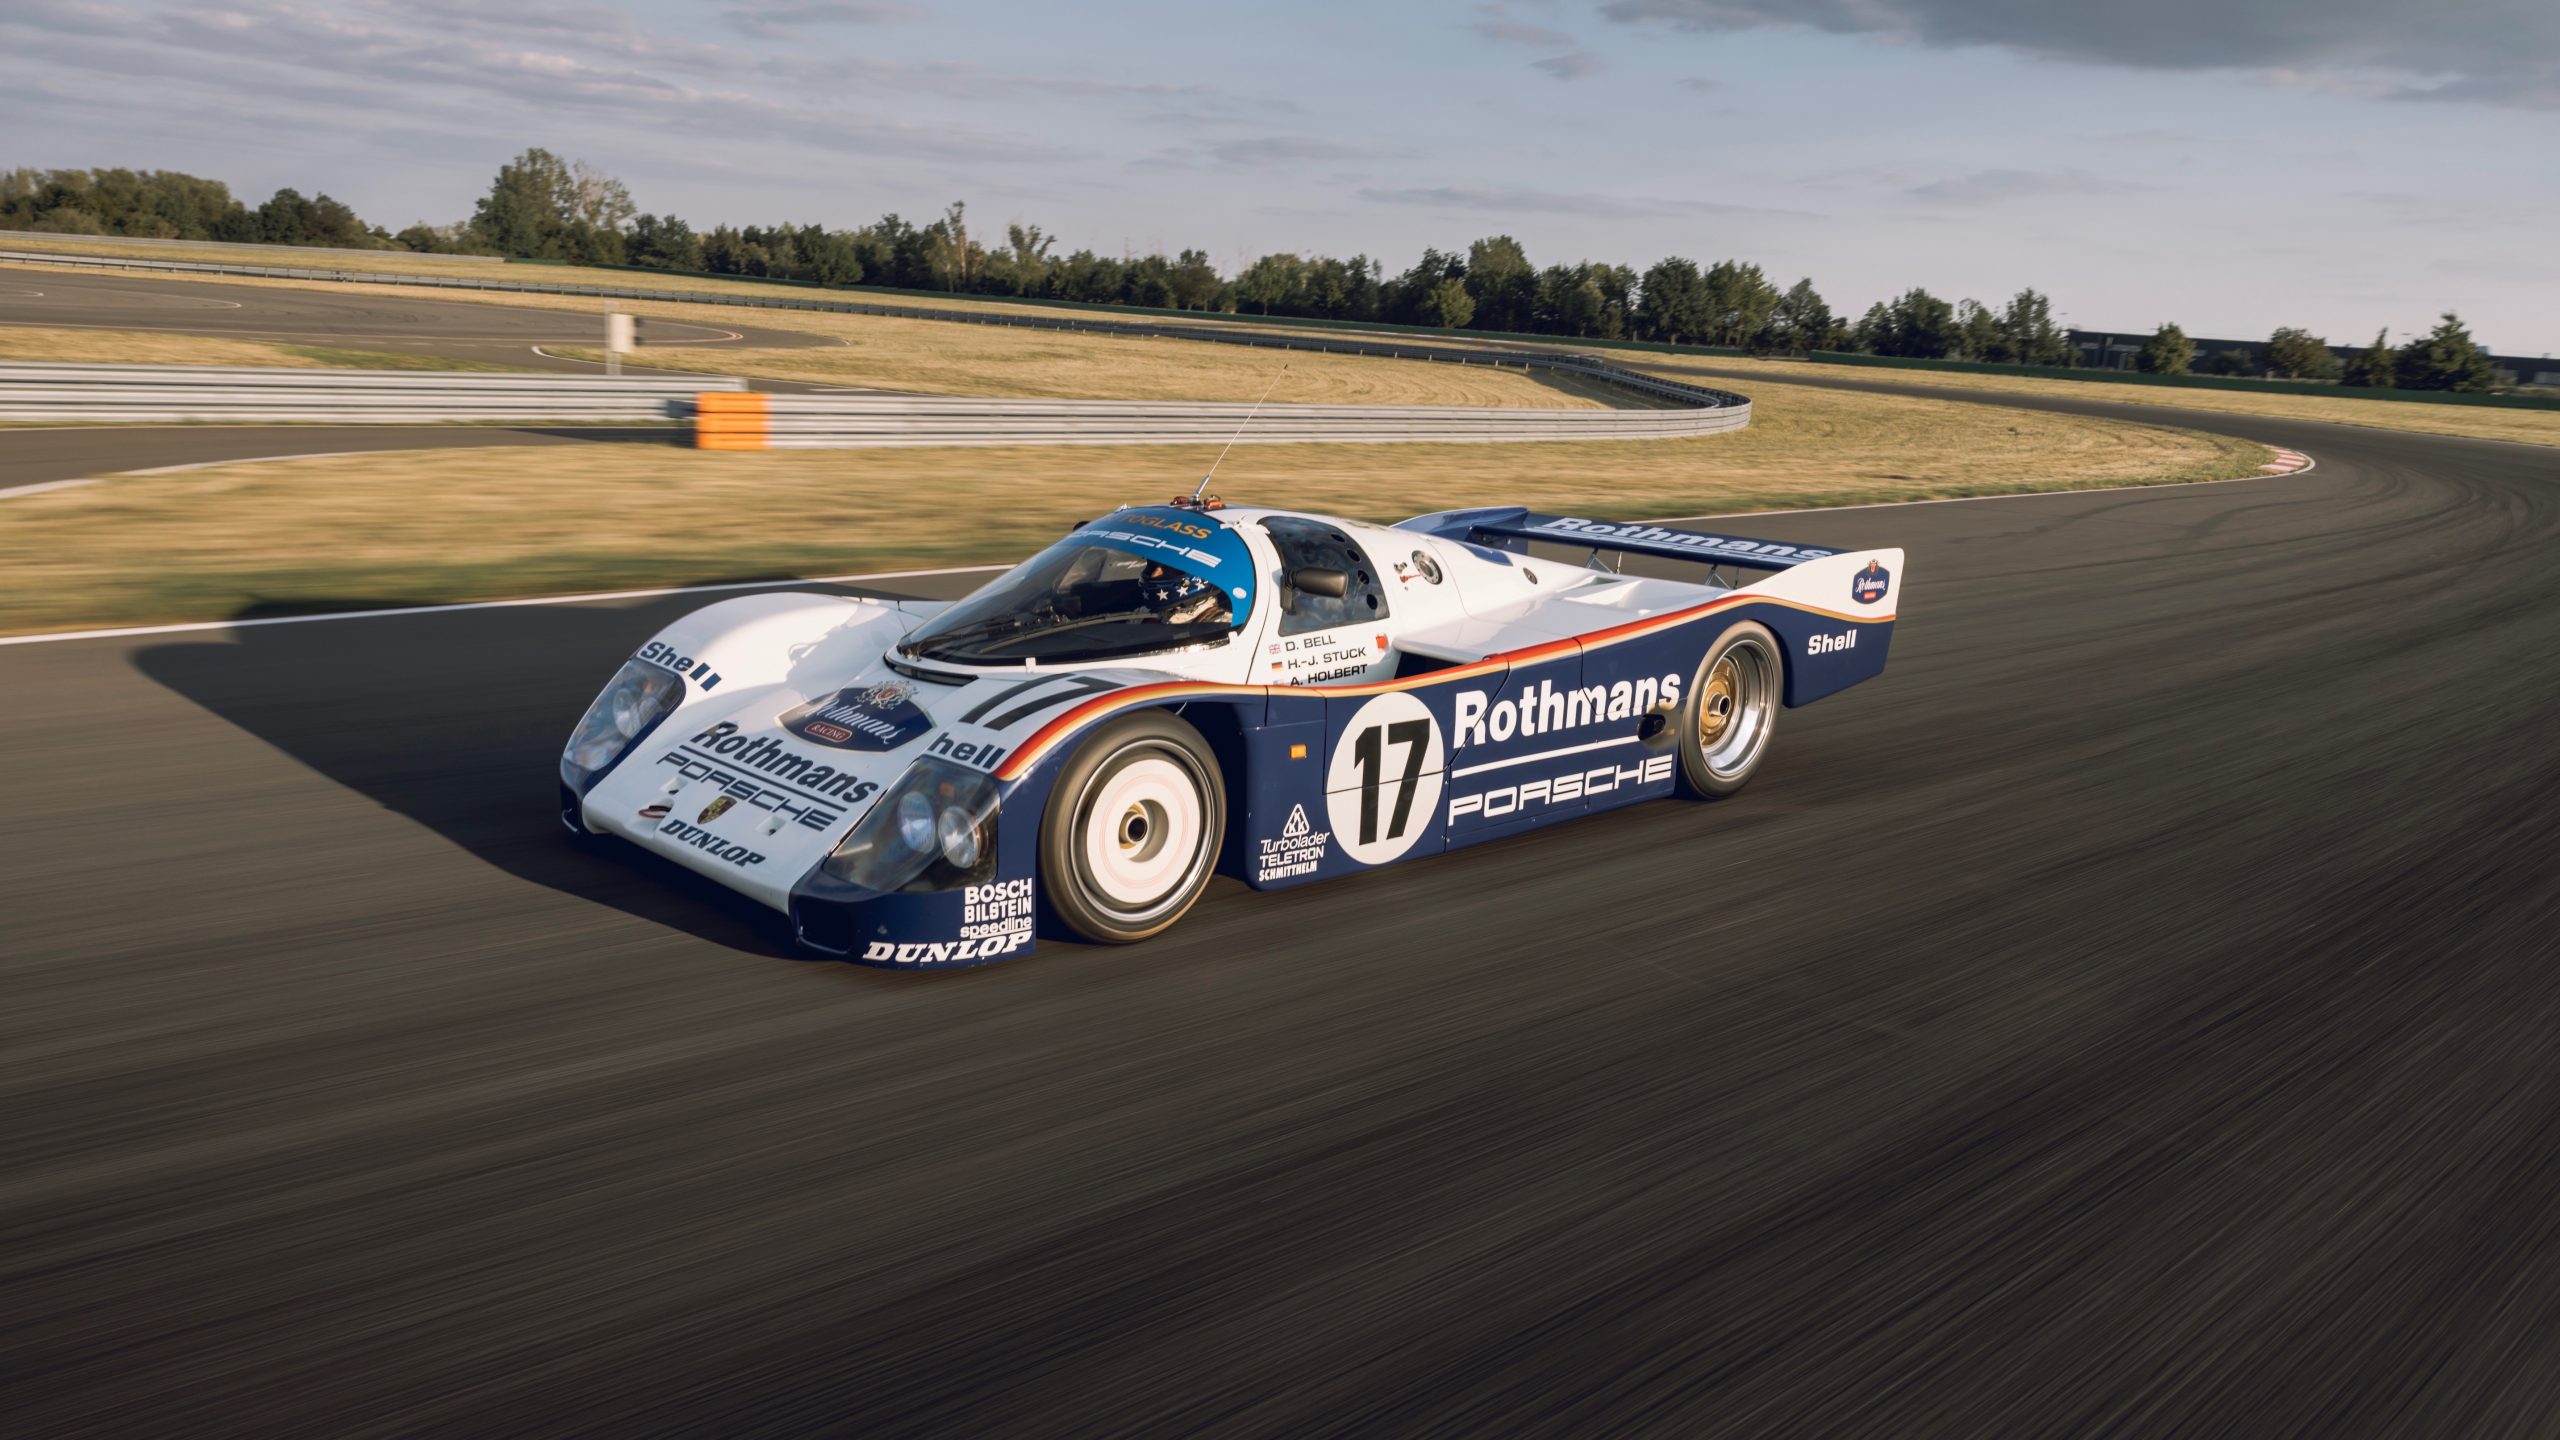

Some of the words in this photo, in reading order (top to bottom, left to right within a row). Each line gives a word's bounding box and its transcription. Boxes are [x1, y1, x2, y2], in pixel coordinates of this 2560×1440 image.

[1543, 517, 1833, 559] Rothmans
[1285, 641, 1299, 651] D.
[1304, 635, 1336, 648] BELL
[1808, 629, 1857, 655] Shell
[641, 641, 722, 692] Shell
[1288, 655, 1318, 669] H.-J.
[1323, 647, 1366, 663] STUCK
[1290, 677, 1303, 686] A.
[1308, 664, 1367, 684] HOLBERT
[1453, 670, 1681, 749] Rothmans
[811, 723, 847, 740] RACING
[690, 720, 878, 804] Rothmans
[928, 732, 1006, 770] hell
[656, 752, 837, 831] PORSCHE
[1354, 718, 1431, 846] 17
[1447, 754, 1672, 827] PORSCHE
[659, 819, 766, 867] DUNLOP
[1261, 832, 1330, 854] Turbolader
[1259, 846, 1324, 868] TELETRON
[1259, 860, 1318, 882] SCHMITTHELM
[965, 878, 1033, 905] BOSCH
[965, 896, 1033, 923] BILSTEIN
[960, 916, 1033, 939] speedline
[862, 930, 1033, 963] DUNLOP
